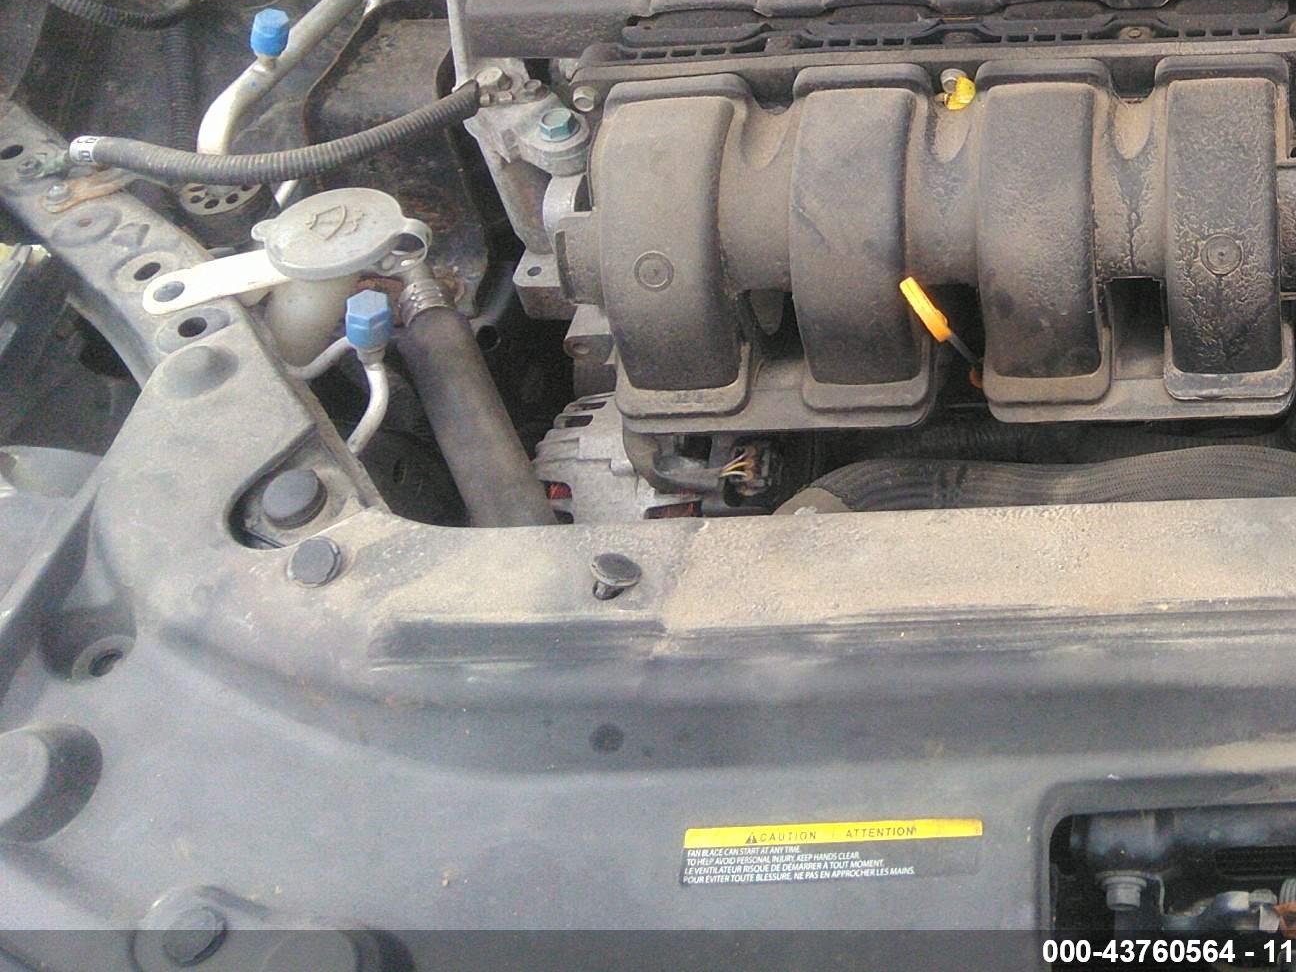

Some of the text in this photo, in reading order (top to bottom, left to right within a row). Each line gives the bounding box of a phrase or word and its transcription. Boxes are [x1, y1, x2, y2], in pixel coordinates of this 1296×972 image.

[760, 826, 915, 842] CAUTION ATTENTION
[687, 849, 702, 857] FAN
[724, 848, 740, 856] CAN
[740, 847, 759, 856] START
[761, 846, 769, 855] AT
[770, 846, 786, 854] ANY
[687, 858, 697, 867] TO
[697, 857, 715, 866] HELP
[715, 856, 736, 866] AVOID
[736, 856, 771, 865] PERSONAL
[796, 853, 813, 862] KEEP
[813, 852, 837, 861] HANDS
[683, 875, 705, 884] POUR
[731, 874, 756, 883] TOUTE
[794, 872, 805, 881] NE
[805, 871, 819, 879] PAS
[820, 870, 830, 879] EN
[831, 868, 876, 878] APPROCHER
[877, 868, 889, 877] LES
[685, 867, 694, 876] LE
[694, 866, 742, 875] VENTILATEUR
[742, 864, 770, 874] RISQUE
[771, 863, 781, 872] DE
[782, 861, 822, 872] DÉMARRER
[830, 860, 849, 870] TOUT
